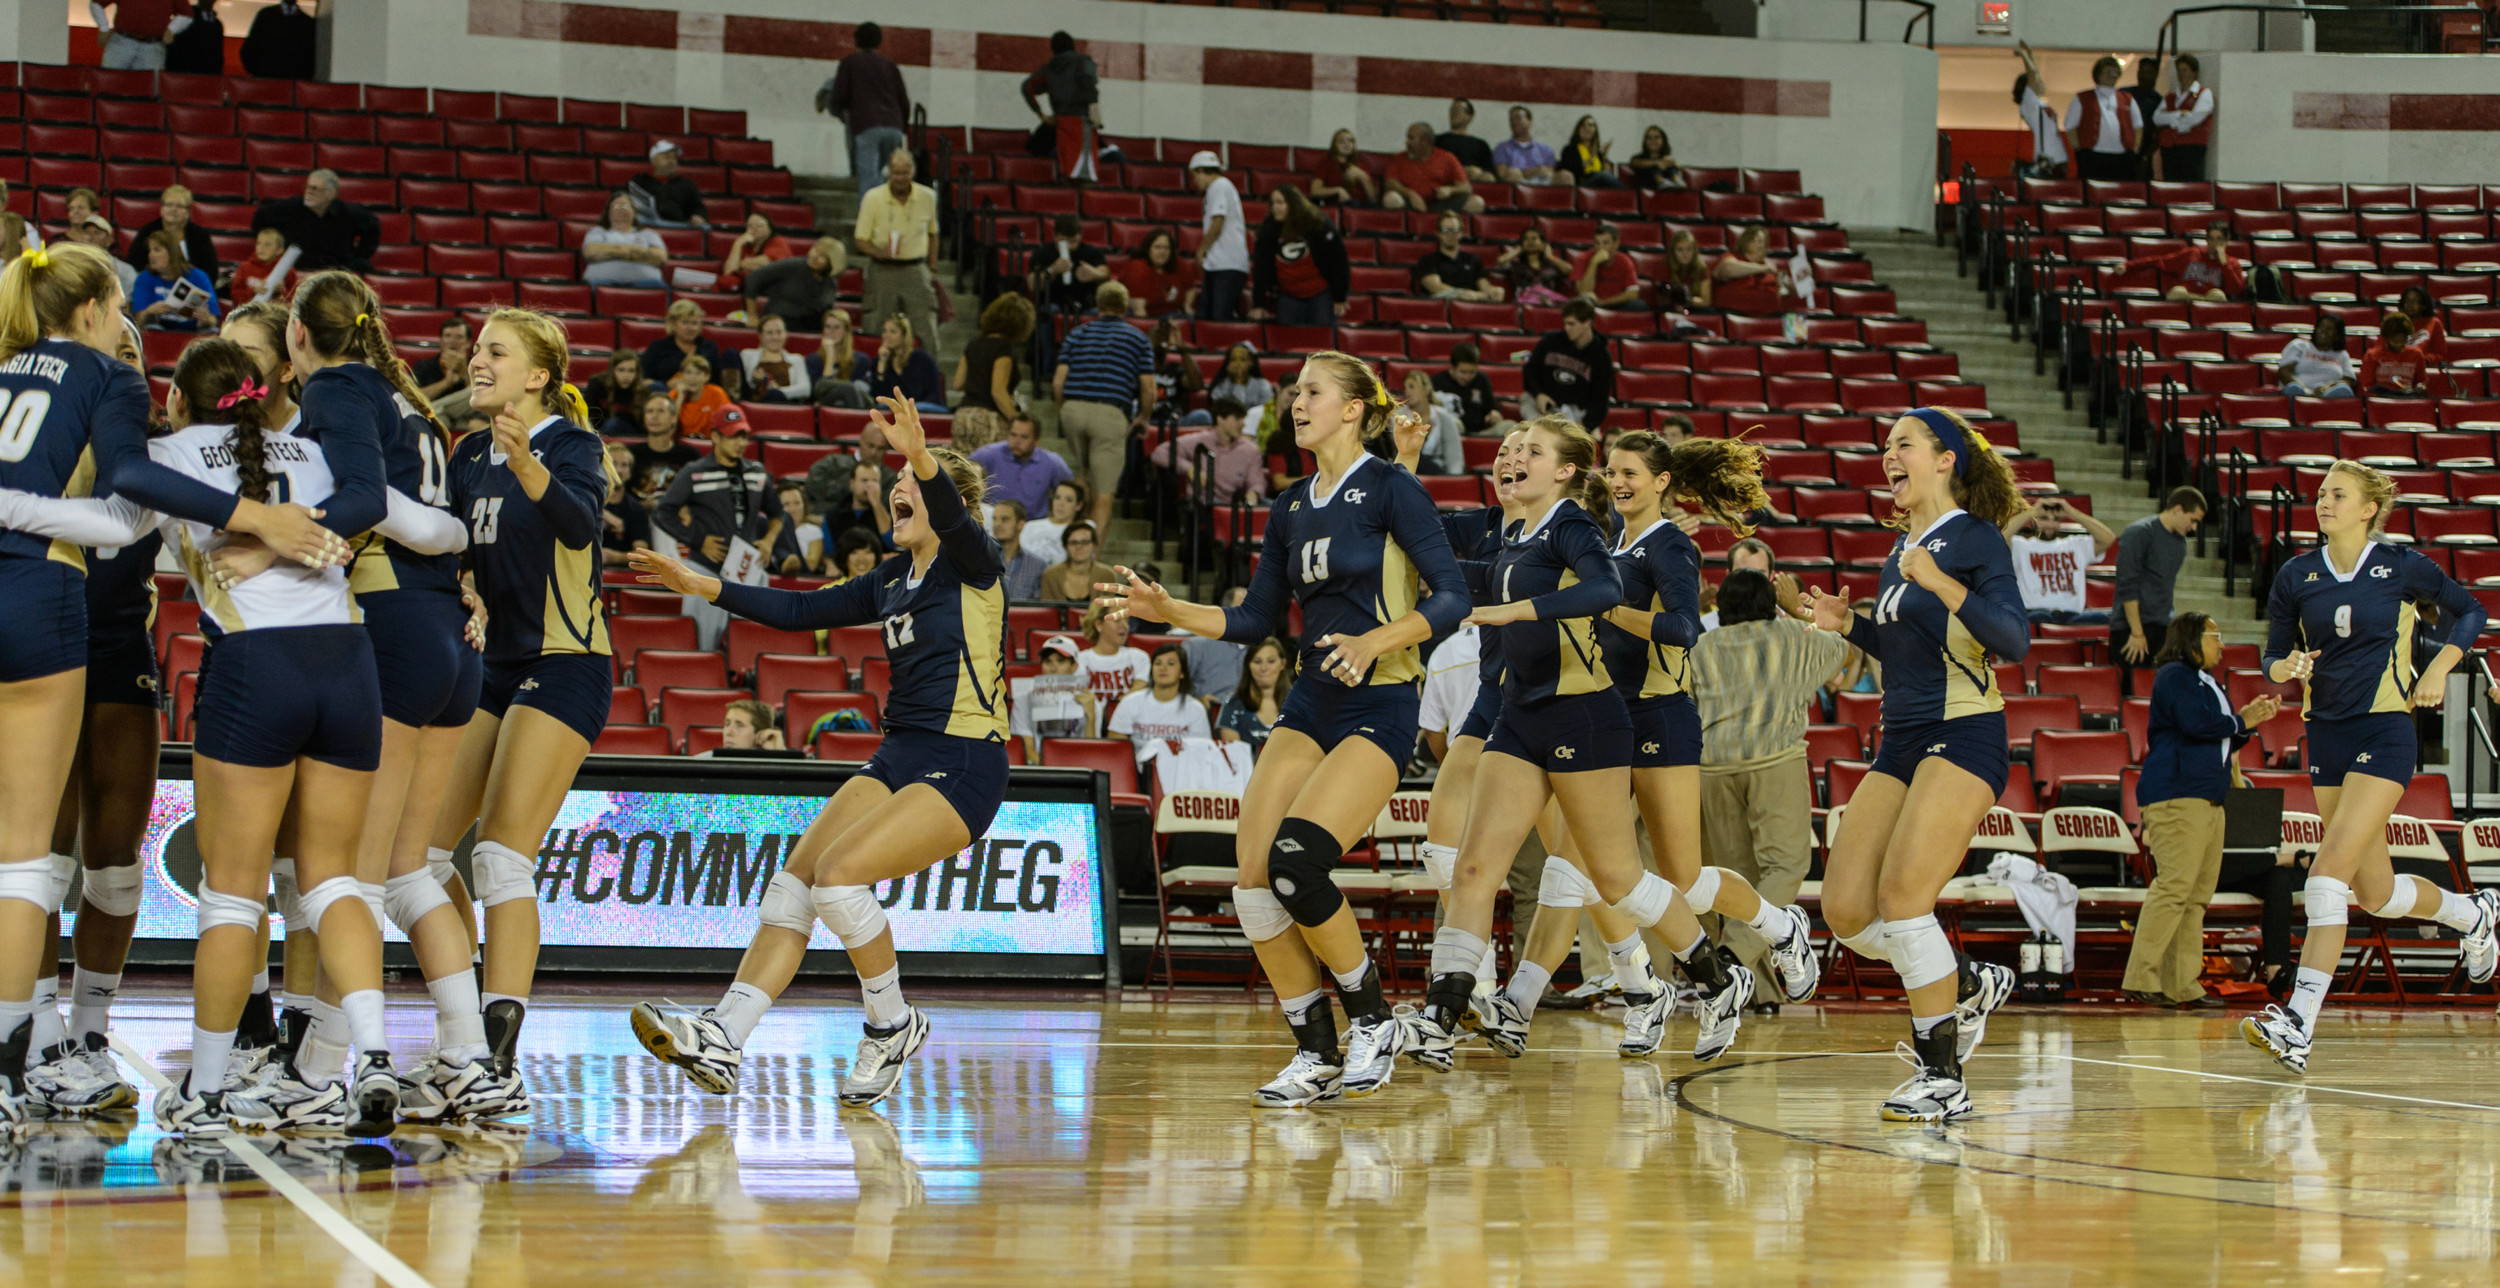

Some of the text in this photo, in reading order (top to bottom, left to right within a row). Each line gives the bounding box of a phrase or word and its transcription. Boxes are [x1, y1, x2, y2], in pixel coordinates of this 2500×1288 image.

[33, 353, 69, 385] TECH
[265, 441, 309, 462] TECH
[472, 497, 504, 545] 23
[1301, 536, 1332, 584] 13
[1501, 564, 1514, 603] 1
[1875, 583, 1909, 626] 14
[884, 611, 915, 650] 12
[2334, 604, 2352, 637] 9
[1086, 664, 1135, 690] WREC
[1172, 795, 1240, 820] GEORGIA
[1389, 798, 1430, 823] GEOR
[1977, 813, 2015, 836] RGIA
[2053, 813, 2121, 838] GEORGIA
[2281, 820, 2325, 844] ORGIA
[2385, 823, 2430, 846] ORGIA
